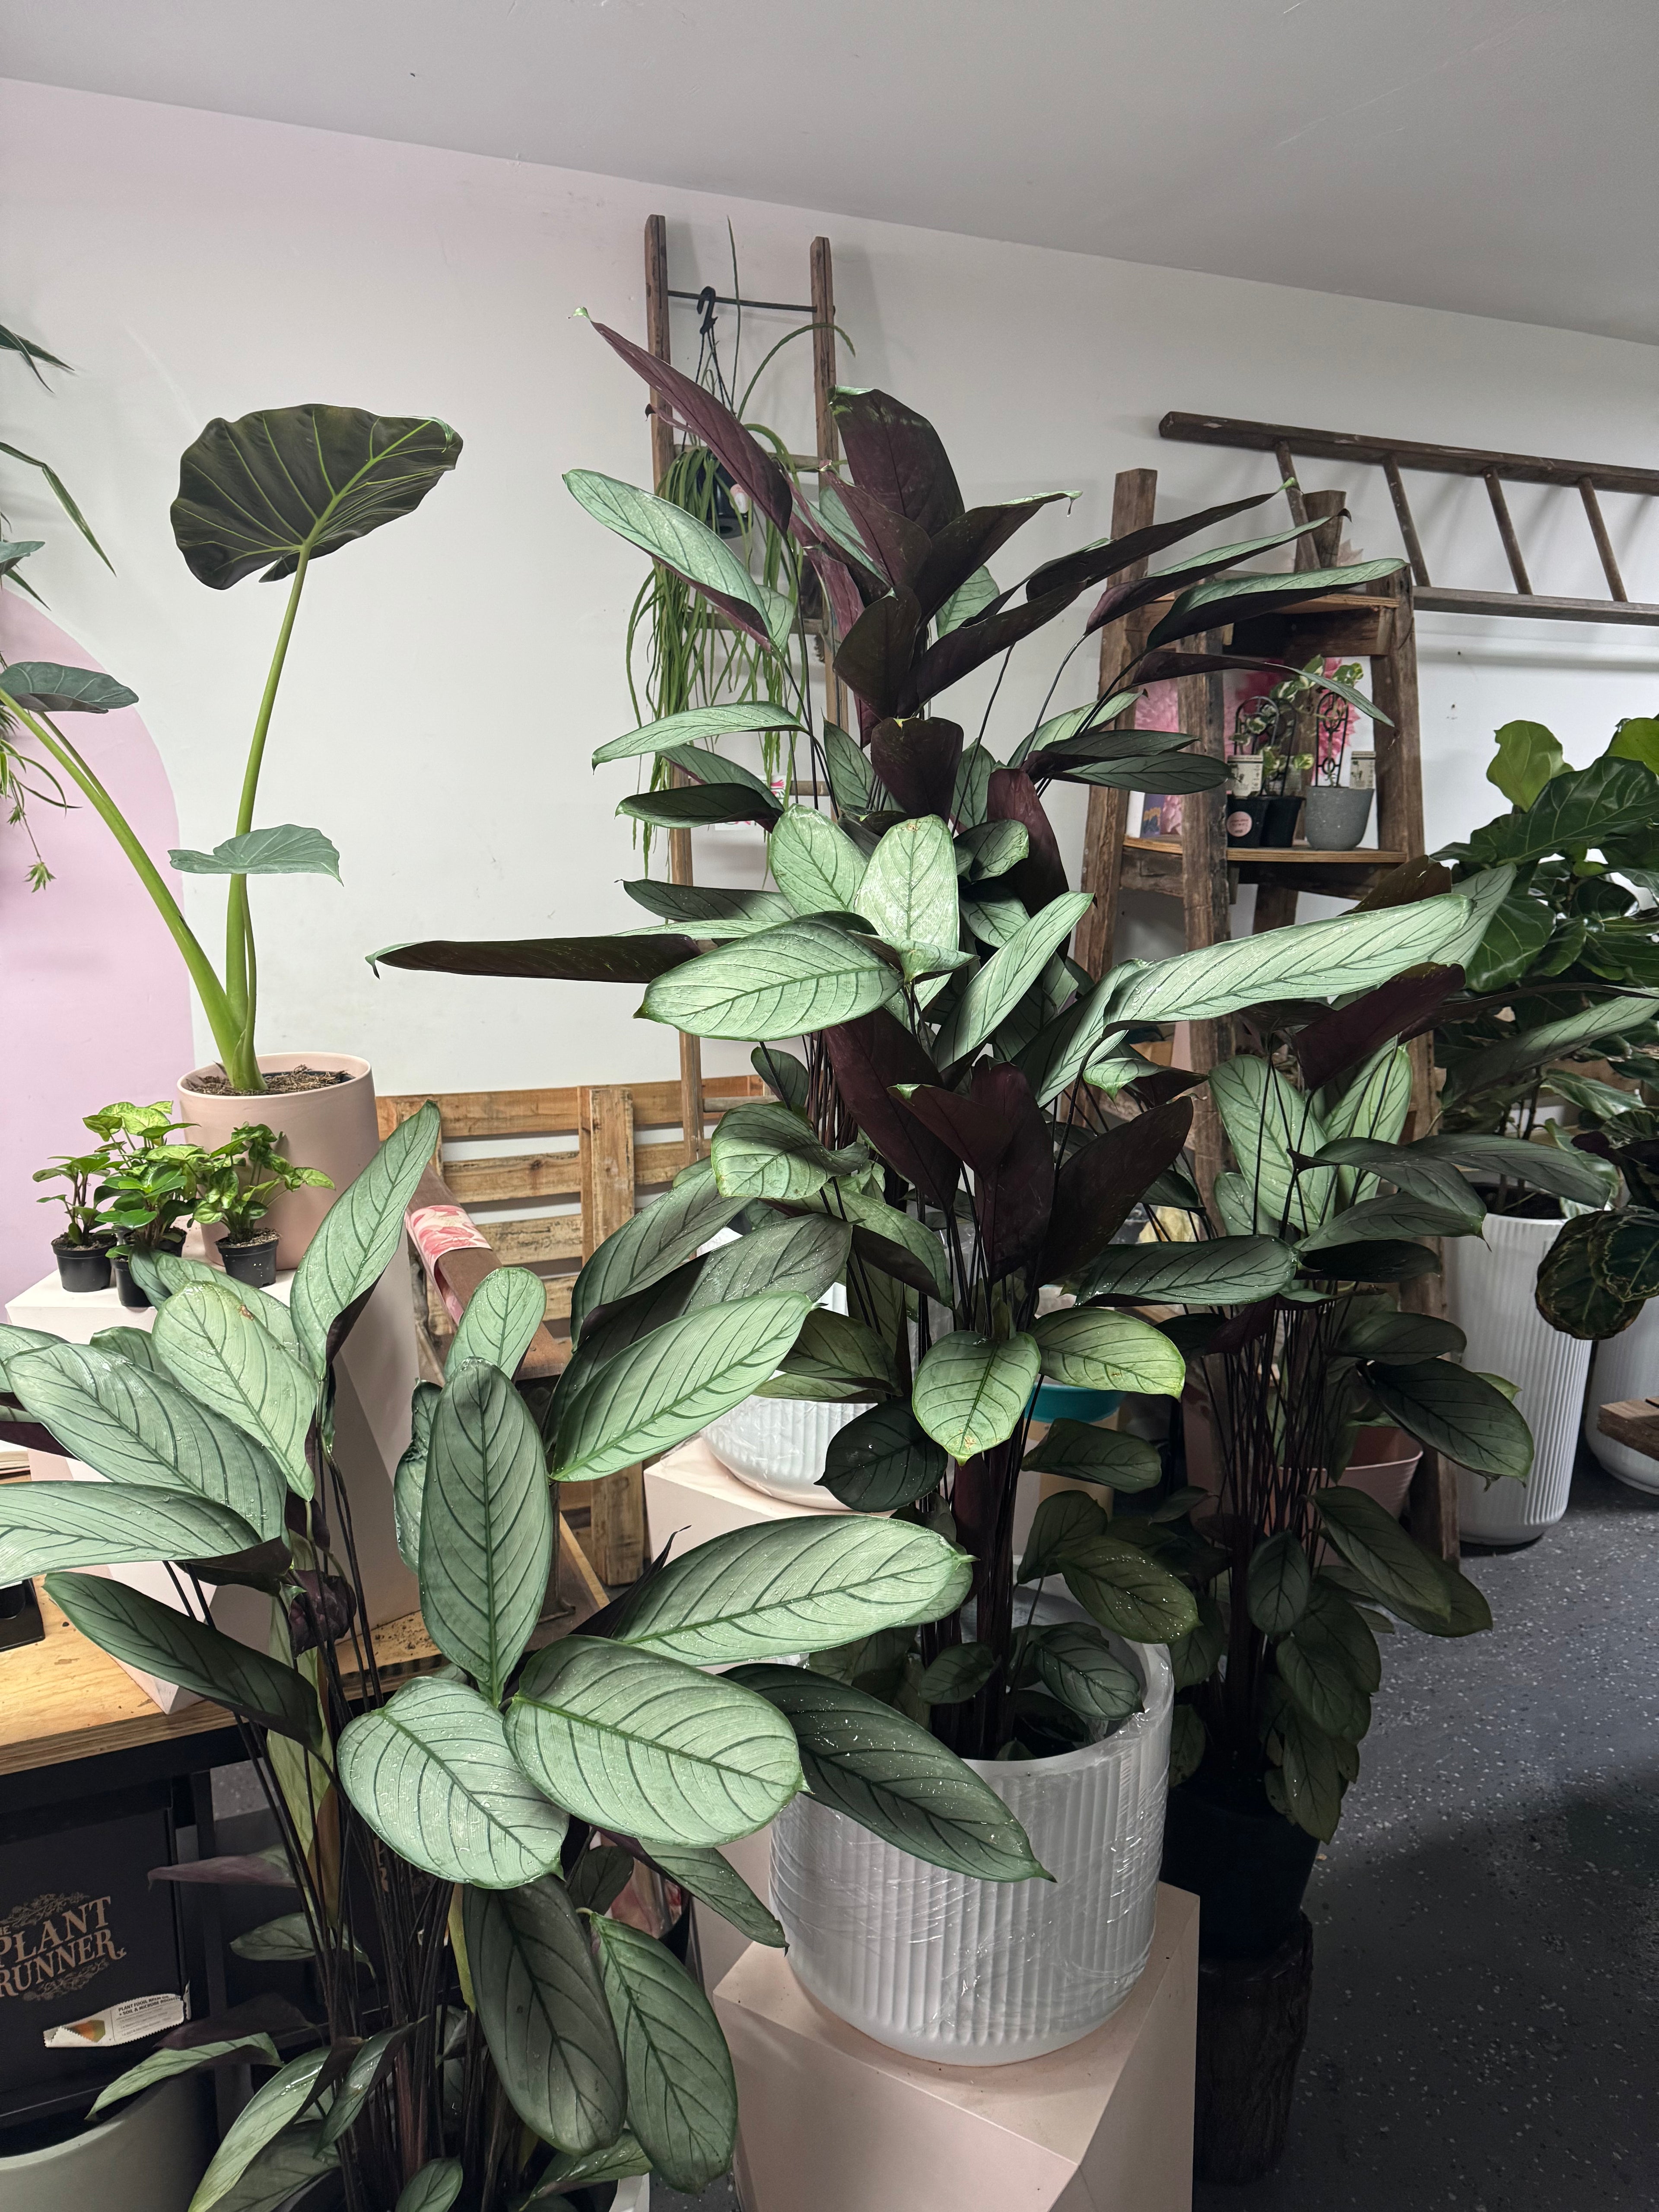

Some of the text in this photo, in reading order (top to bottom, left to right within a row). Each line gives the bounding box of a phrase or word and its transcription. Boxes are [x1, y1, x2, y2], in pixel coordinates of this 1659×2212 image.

[0, 1896, 111, 1968] PLANT
[0, 1929, 127, 1997] RUNNER
[118, 2003, 133, 2012] PLANT
[139, 2001, 159, 2009] MICROBE
